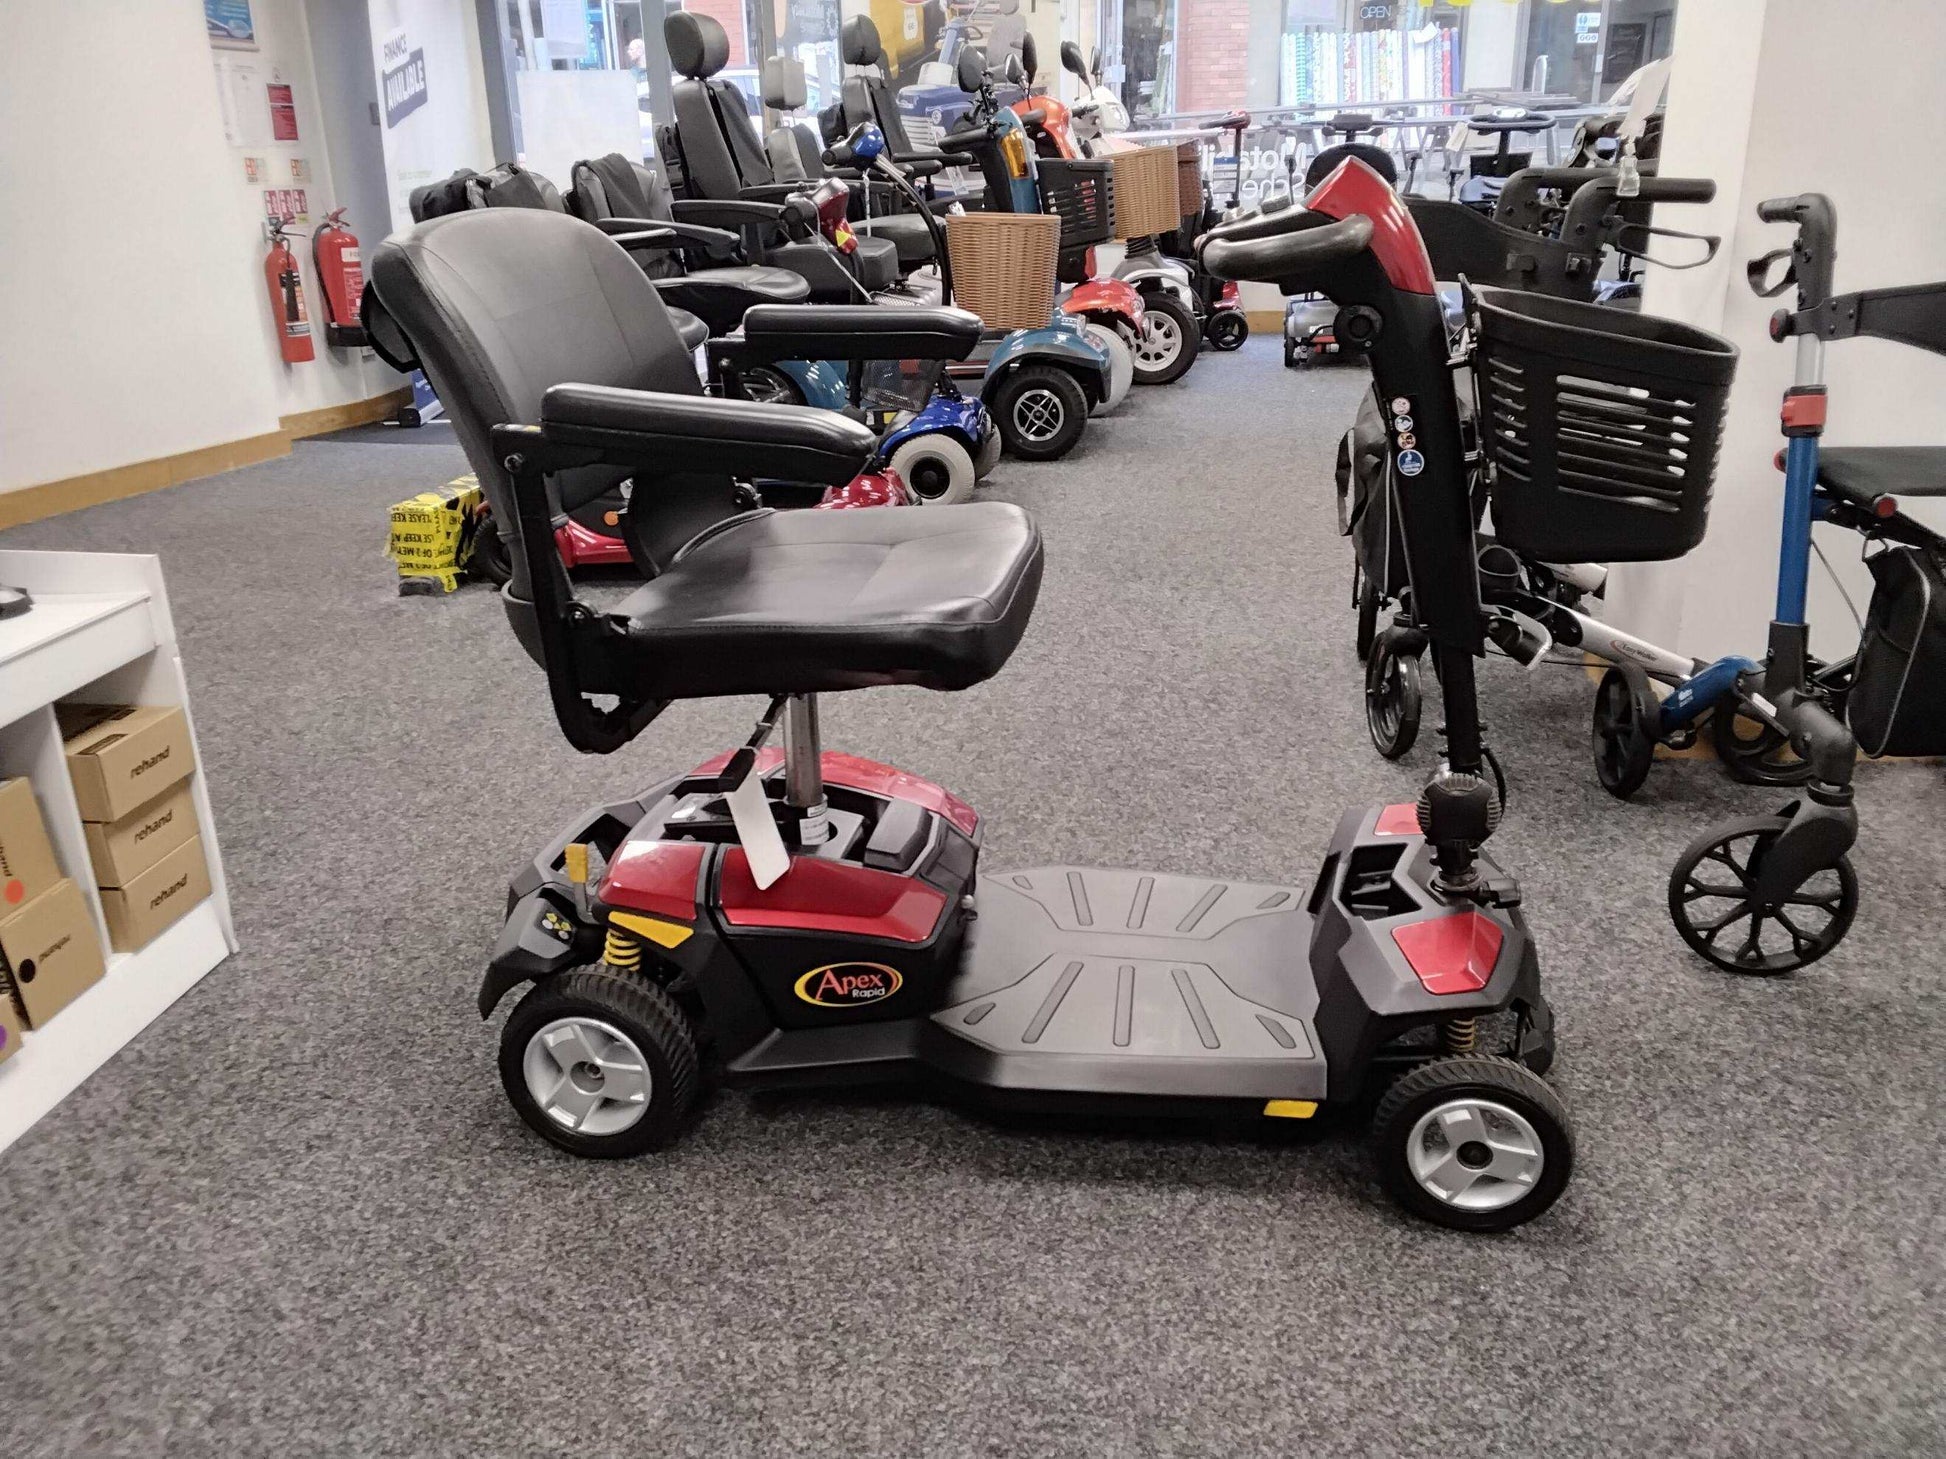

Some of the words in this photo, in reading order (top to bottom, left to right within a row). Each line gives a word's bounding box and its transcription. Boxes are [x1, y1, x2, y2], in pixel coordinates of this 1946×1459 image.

[1360, 5, 1392, 19] OPEN
[131, 744, 170, 779] rehand
[134, 807, 173, 845] rehand
[150, 872, 188, 911] rehand
[815, 969, 884, 1002] Apex
[852, 987, 886, 998] Rapid
